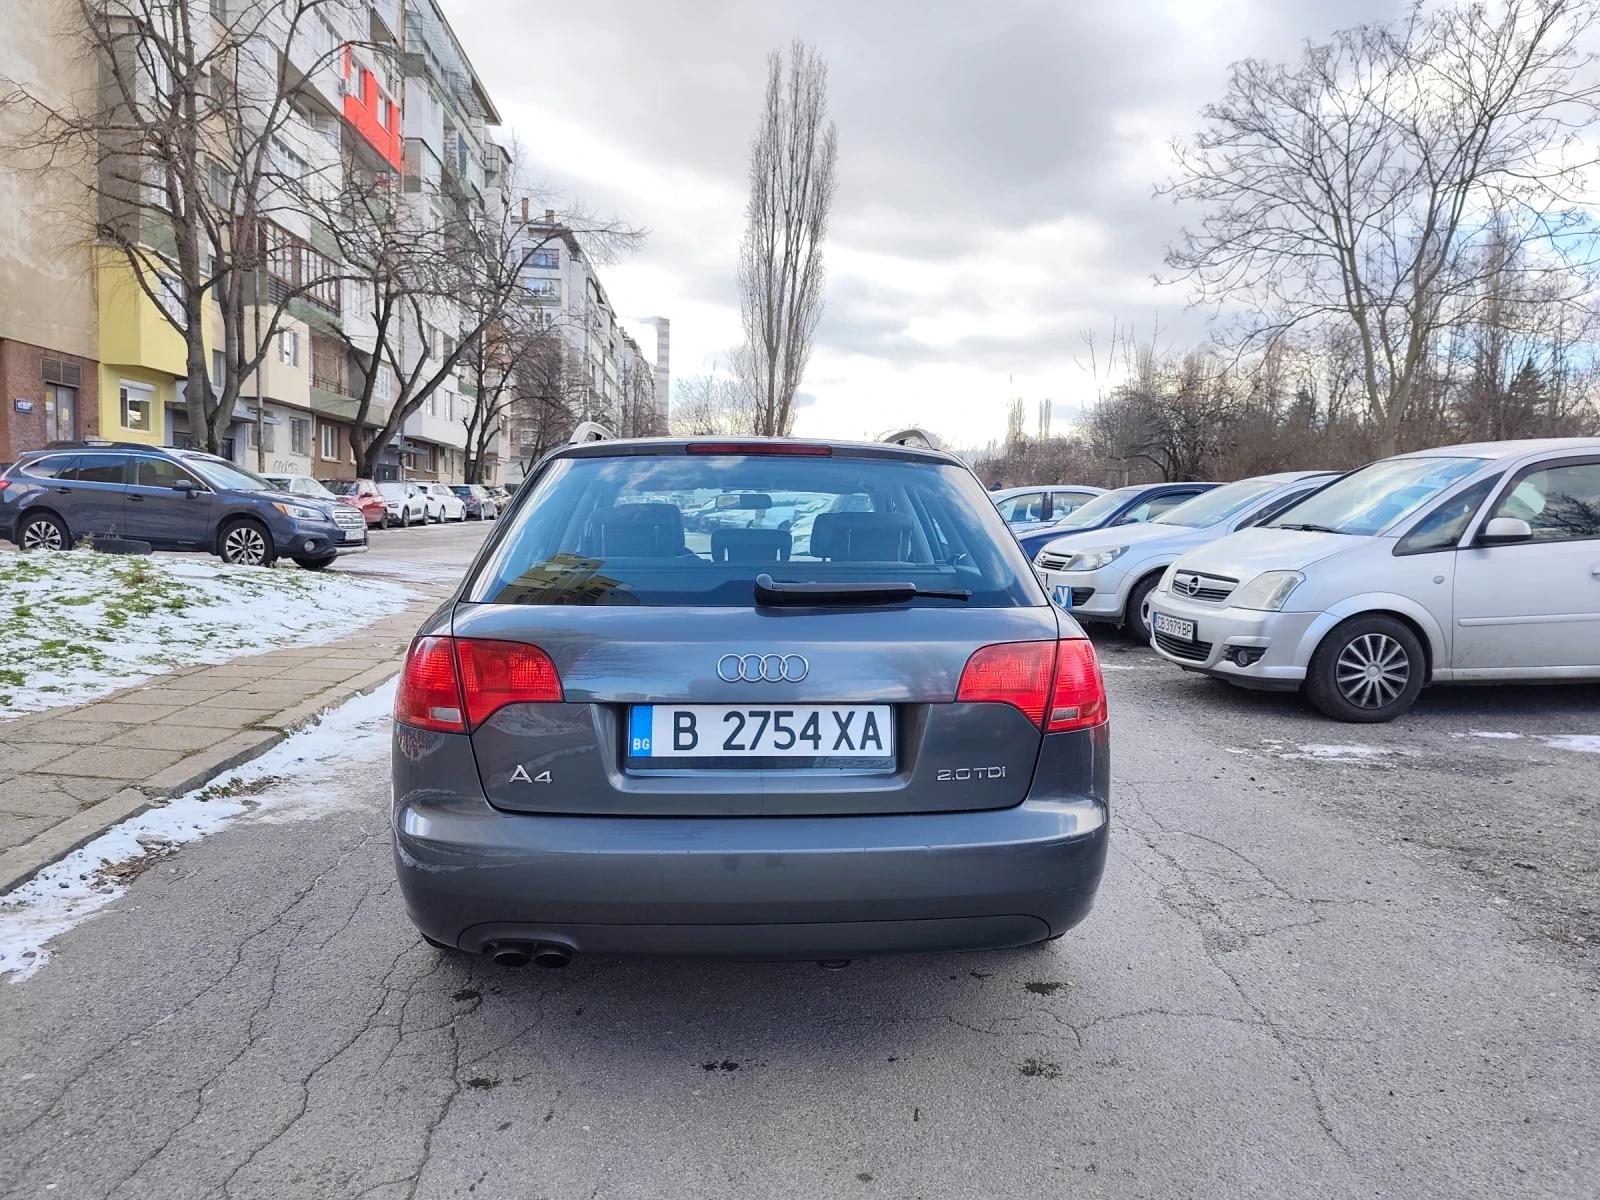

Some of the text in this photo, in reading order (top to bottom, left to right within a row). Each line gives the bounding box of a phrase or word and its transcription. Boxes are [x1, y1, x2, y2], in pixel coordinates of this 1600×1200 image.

[673, 710, 884, 751] B 2754 XA
[633, 737, 650, 751] BG
[508, 764, 553, 784] A4
[936, 768, 971, 781] 2.0
